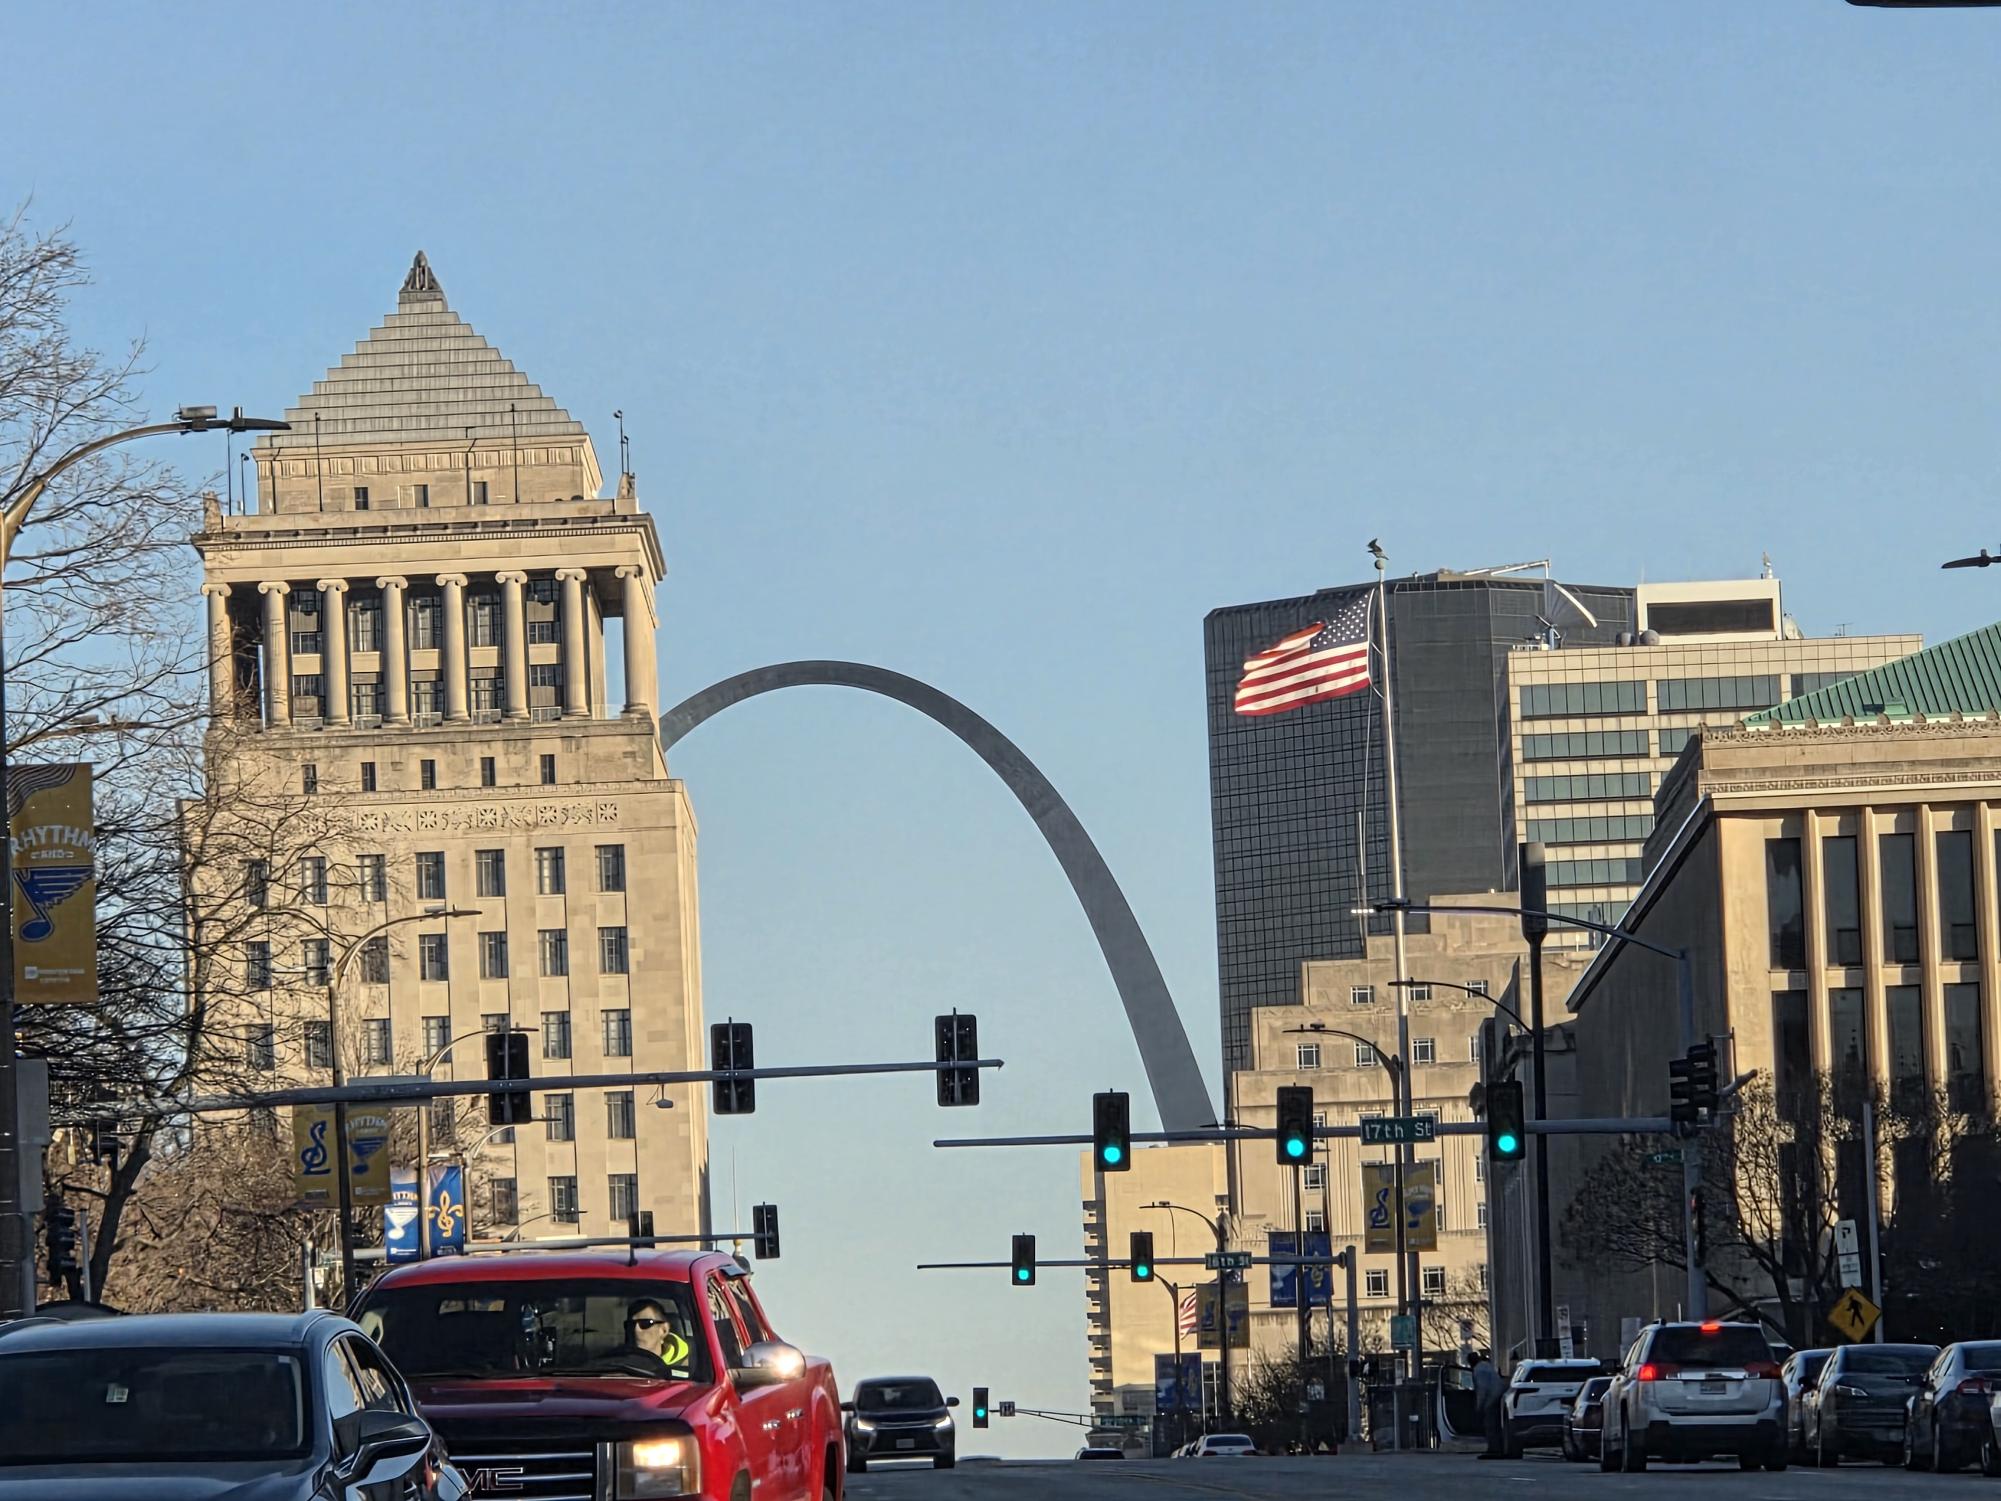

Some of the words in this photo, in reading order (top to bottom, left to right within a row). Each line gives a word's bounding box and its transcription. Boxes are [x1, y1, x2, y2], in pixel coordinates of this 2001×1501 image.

[1365, 1123, 1404, 1139] 17th
[1414, 1121, 1431, 1136] St
[456, 1467, 524, 1491] MC
